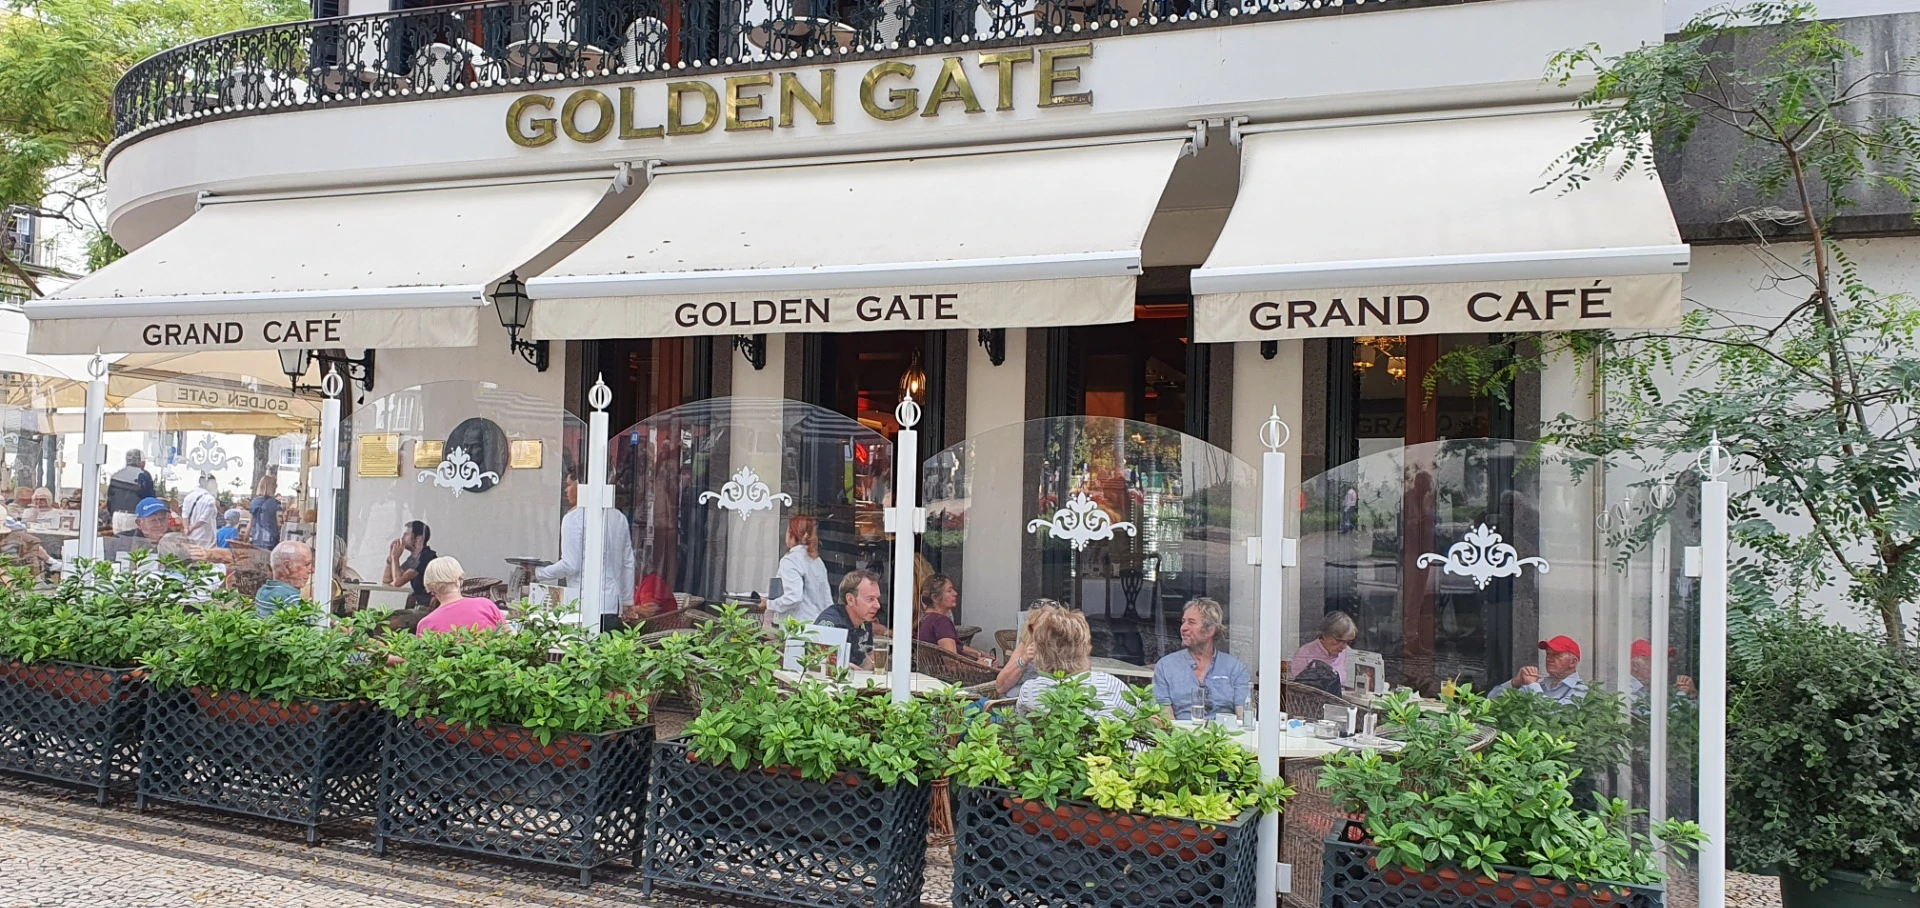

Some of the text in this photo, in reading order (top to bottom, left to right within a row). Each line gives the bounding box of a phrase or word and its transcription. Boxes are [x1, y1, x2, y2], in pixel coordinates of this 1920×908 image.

[505, 43, 1094, 148] GOLDEN GATE
[674, 293, 959, 328] GOLDEN GATE
[1249, 279, 1612, 331] GRAND CAFÉ
[142, 313, 342, 346] GRAND CAFÉ
